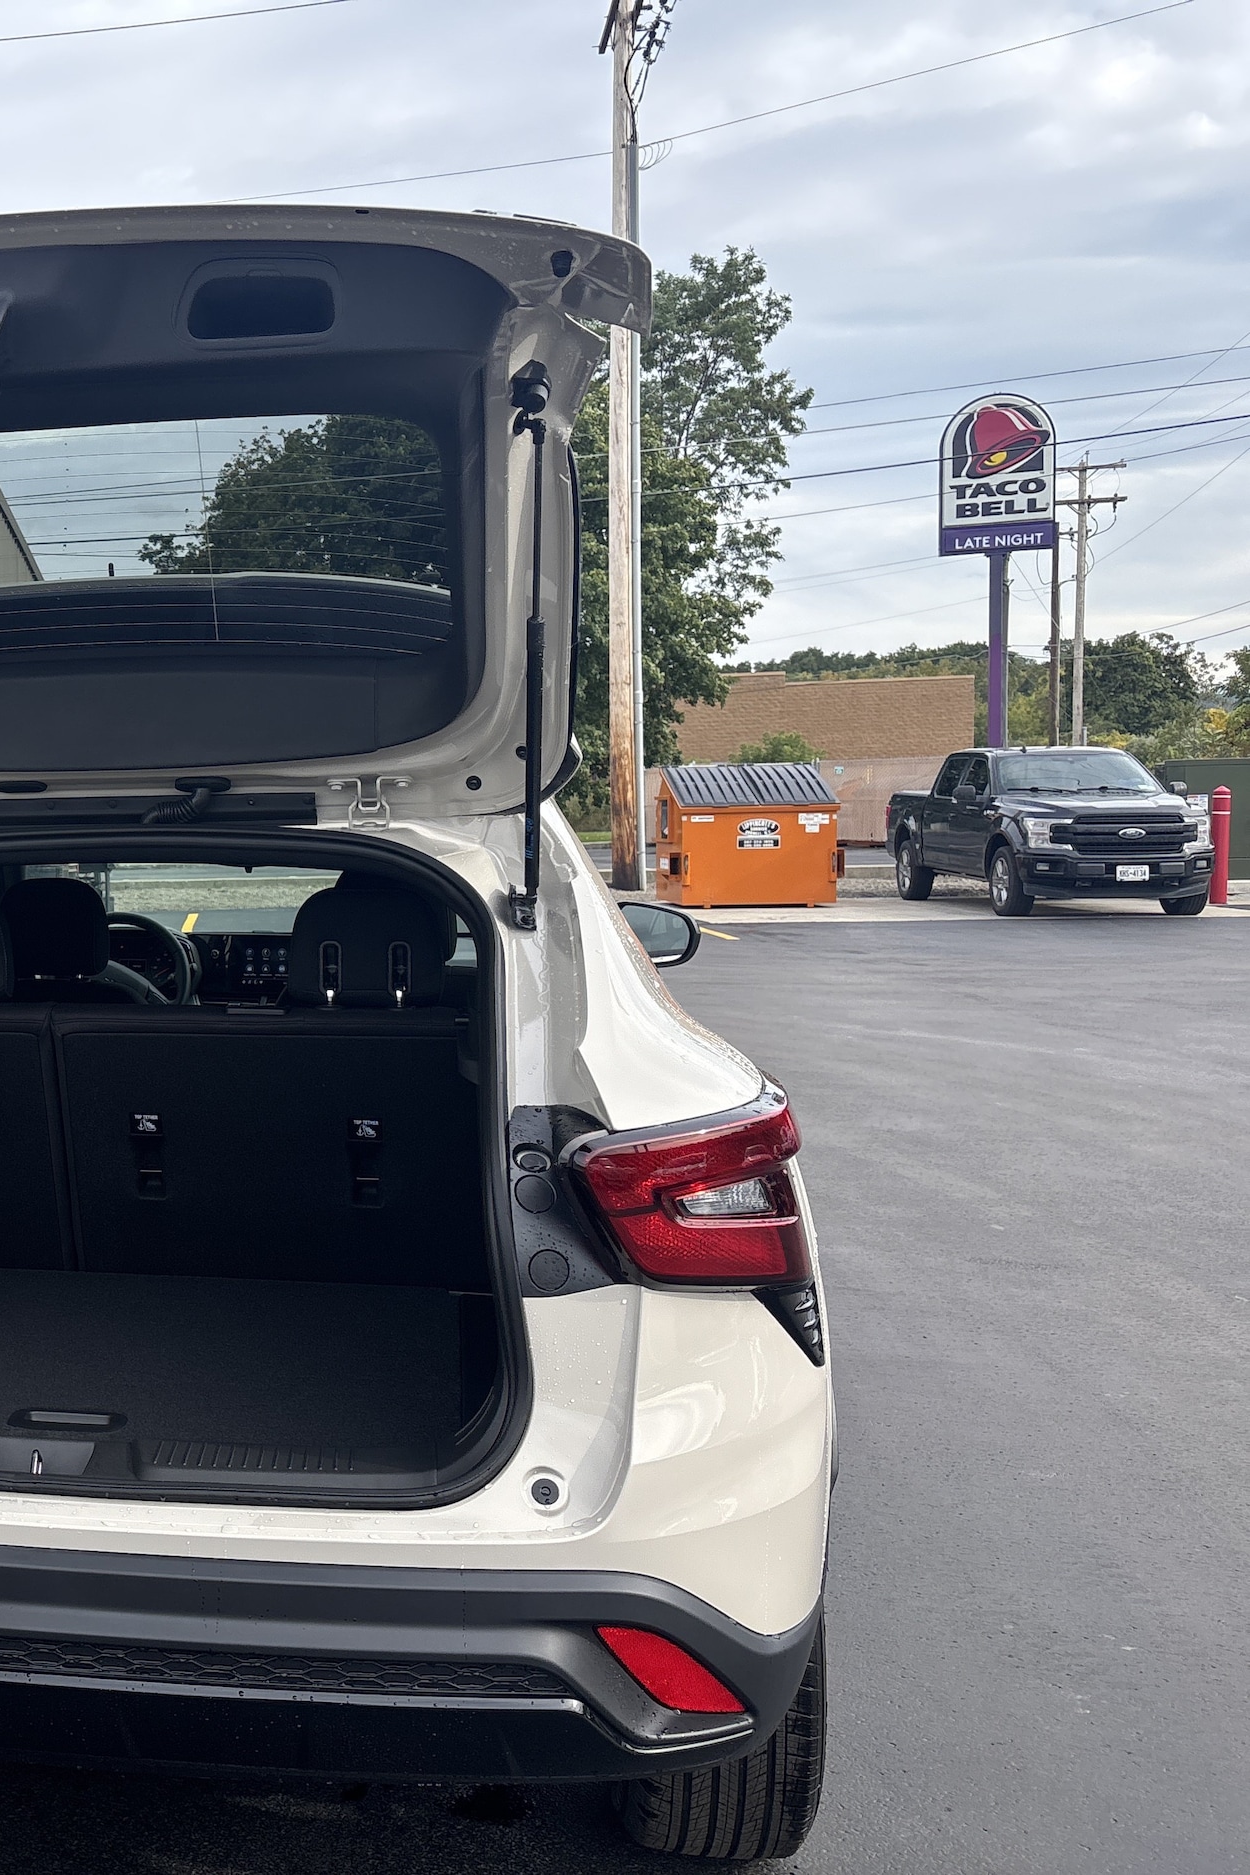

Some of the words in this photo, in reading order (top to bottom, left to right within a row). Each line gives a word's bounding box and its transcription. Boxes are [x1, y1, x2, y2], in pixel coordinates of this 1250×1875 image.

[949, 478, 1047, 500] TACO
[956, 498, 1050, 519] BELL
[955, 536, 991, 550] LATE
[994, 533, 1044, 547] NIGHT
